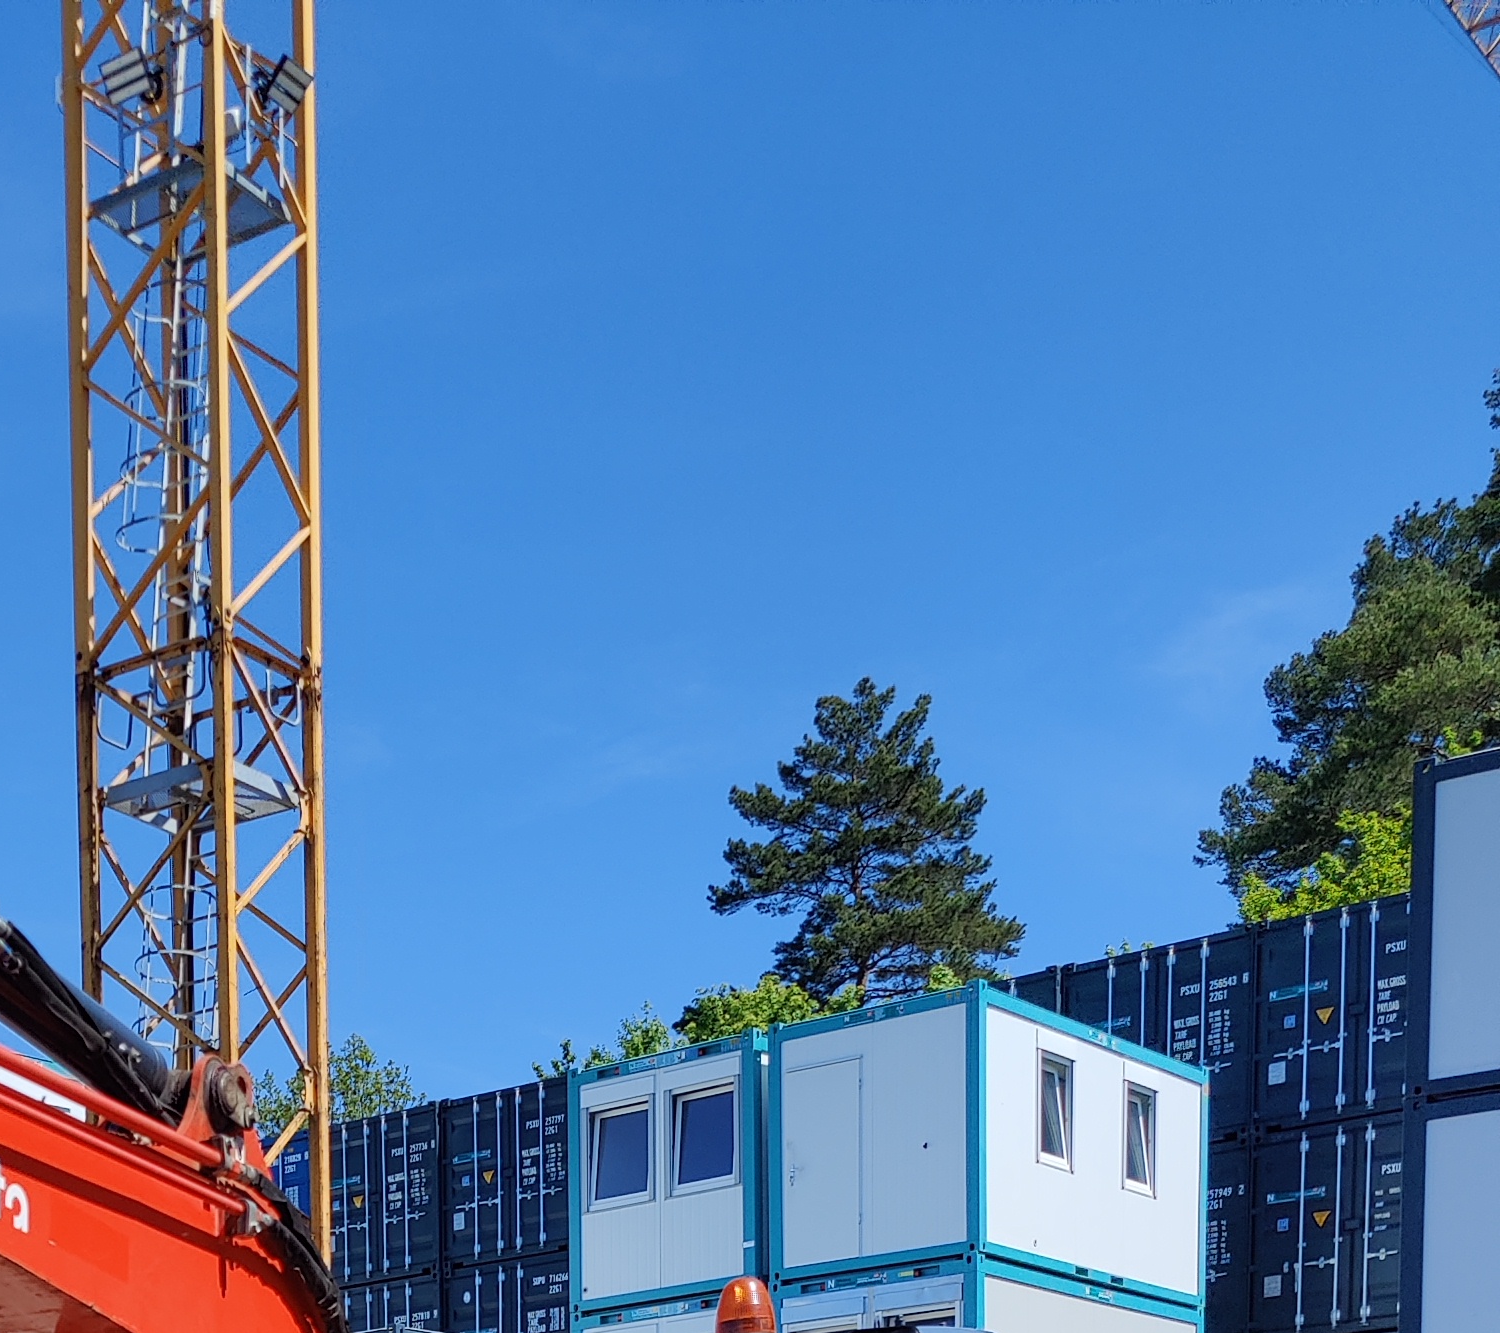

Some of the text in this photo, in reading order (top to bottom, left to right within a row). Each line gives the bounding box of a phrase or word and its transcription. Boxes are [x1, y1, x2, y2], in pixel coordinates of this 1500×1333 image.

[1385, 940, 1407, 954] PSXU
[1180, 983, 1200, 997] PSXU
[1208, 976, 1238, 991] 256543
[1381, 1162, 1401, 1176] PSXU
